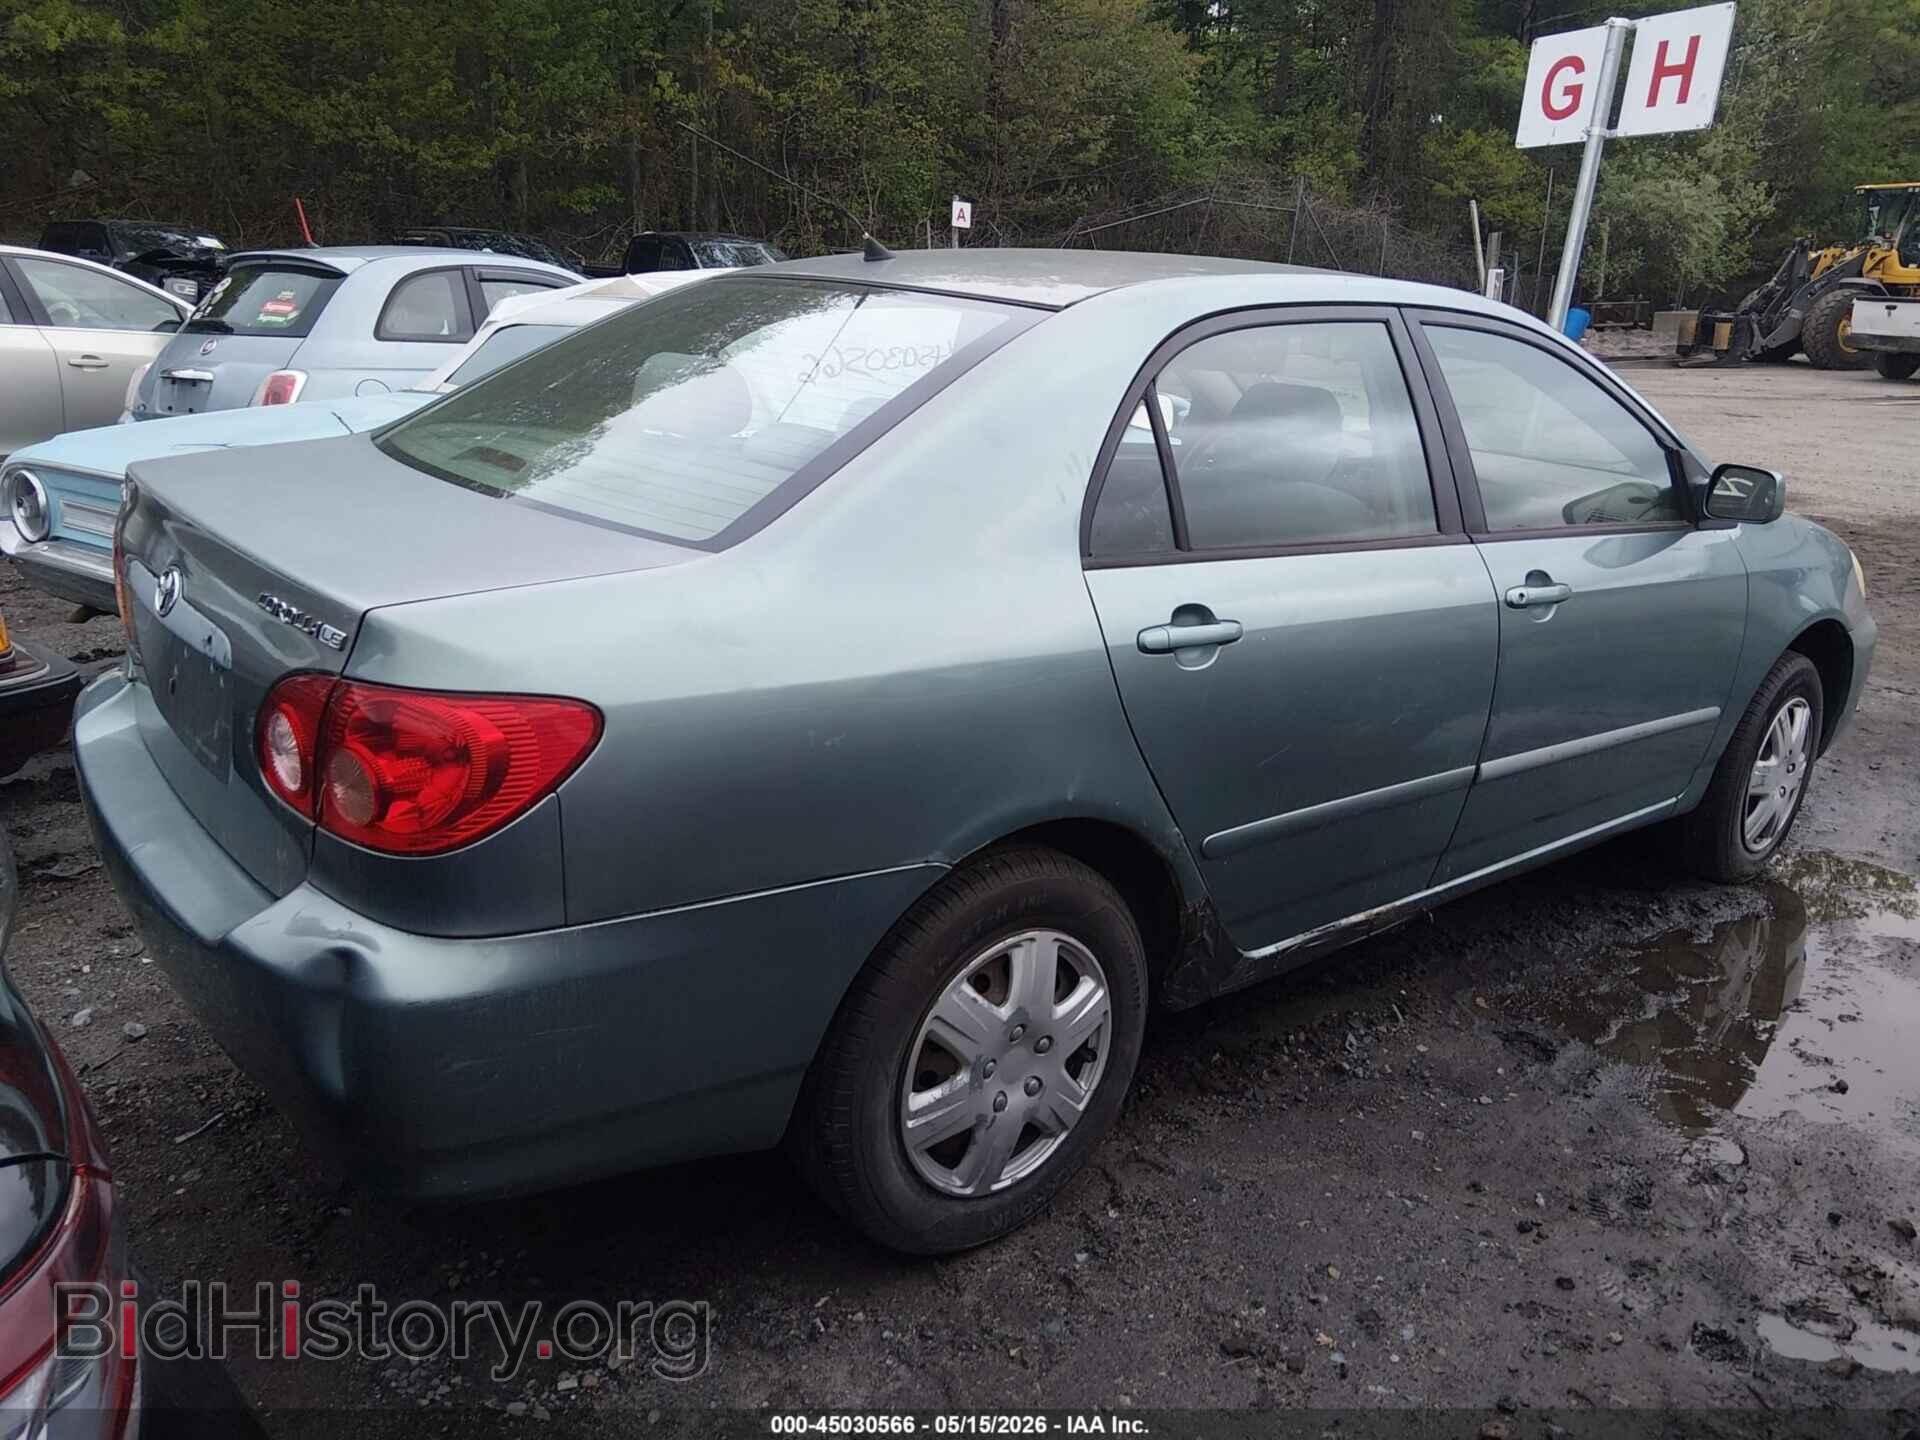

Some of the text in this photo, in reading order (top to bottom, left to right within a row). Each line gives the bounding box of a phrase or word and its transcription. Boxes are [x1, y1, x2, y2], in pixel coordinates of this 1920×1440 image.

[1541, 55, 1585, 121] G
[1646, 35, 1702, 108] H
[956, 207, 967, 222] A
[319, 623, 347, 651] LE
